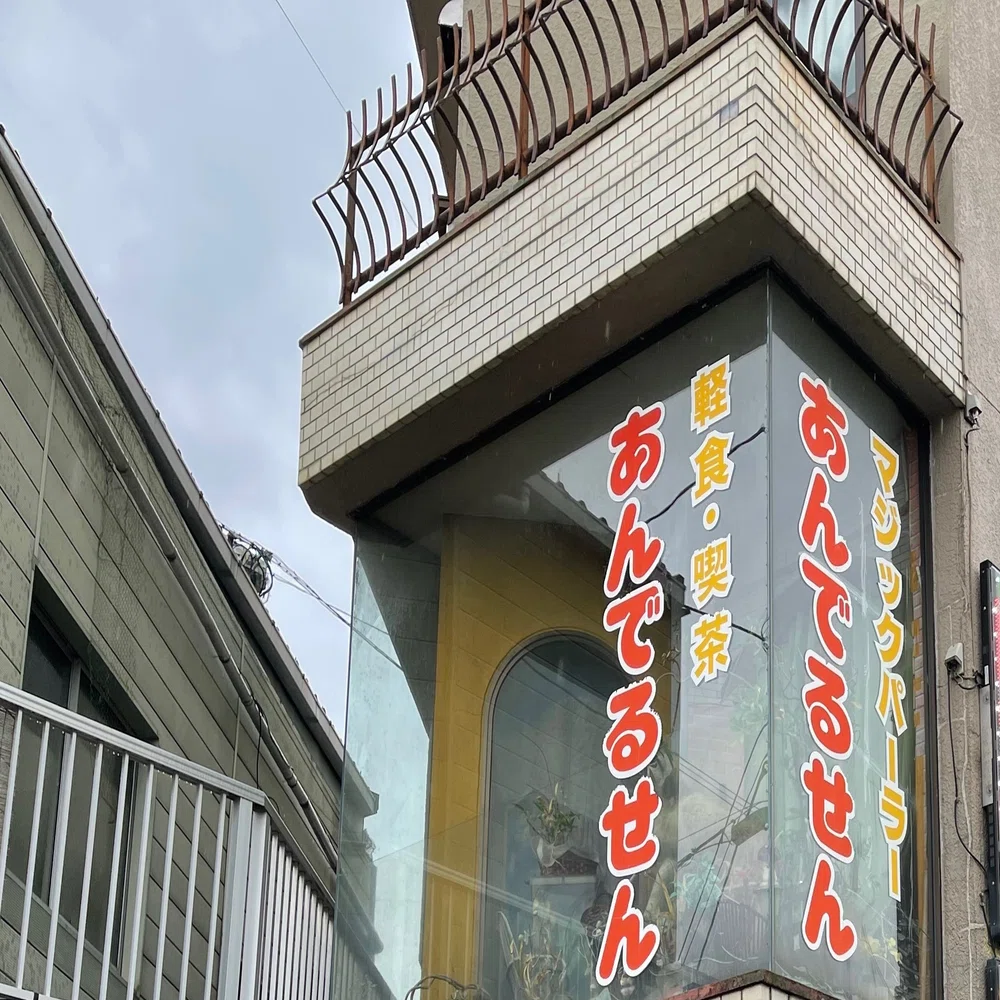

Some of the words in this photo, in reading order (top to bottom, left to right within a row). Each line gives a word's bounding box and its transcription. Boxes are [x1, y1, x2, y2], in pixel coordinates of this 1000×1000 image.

[596, 401, 665, 986] あんでるせん
[690, 355, 735, 687] 軽食・喫茶
[797, 372, 857, 961] あんでるせん
[869, 428, 908, 901] マジックパーラー
